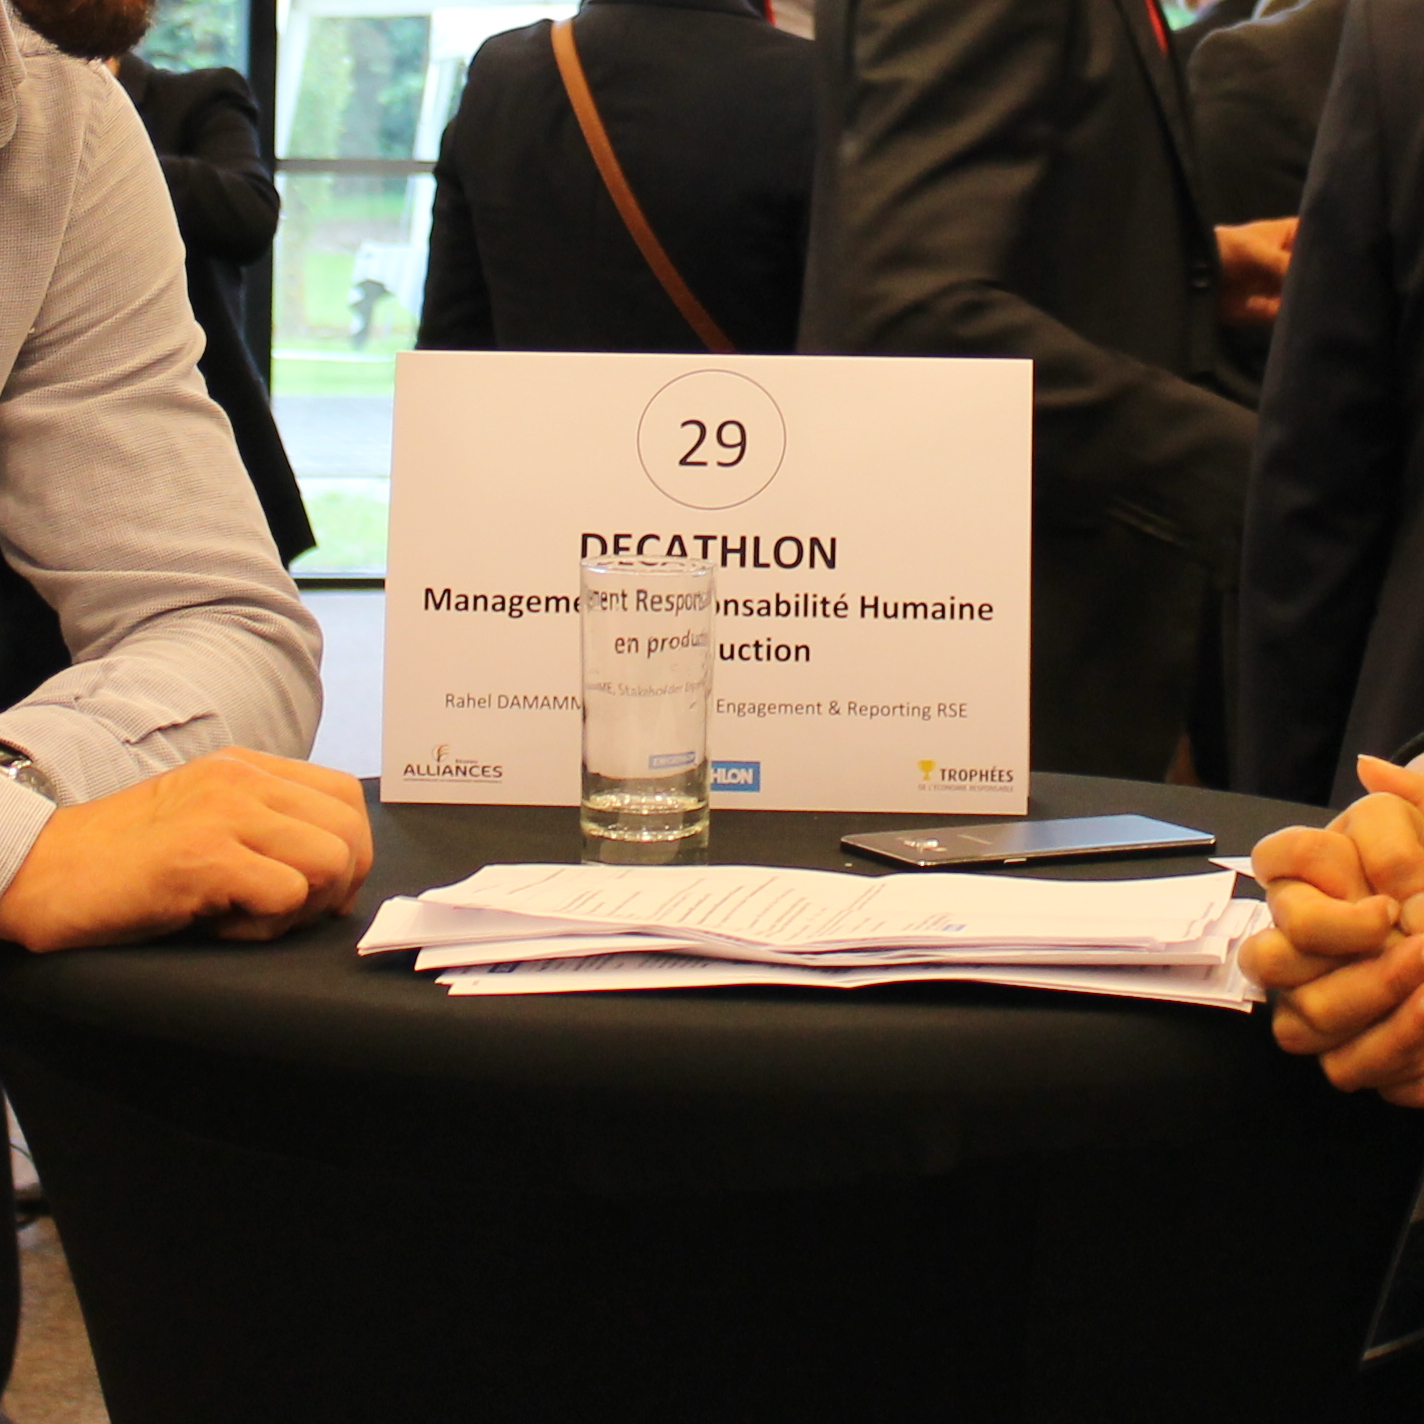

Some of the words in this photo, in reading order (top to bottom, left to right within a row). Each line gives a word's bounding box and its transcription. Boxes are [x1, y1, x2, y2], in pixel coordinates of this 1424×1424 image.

[677, 418, 748, 469] 29
[580, 532, 838, 570] DECATHLON
[859, 594, 994, 622] Humaine
[445, 692, 492, 709] Rahel
[716, 698, 823, 719] Engagement
[827, 699, 842, 716] &
[847, 700, 932, 722] Reporting
[936, 702, 968, 719] RSE
[403, 763, 503, 778] ALLIANCES
[940, 766, 1014, 783] TROPHÉES
